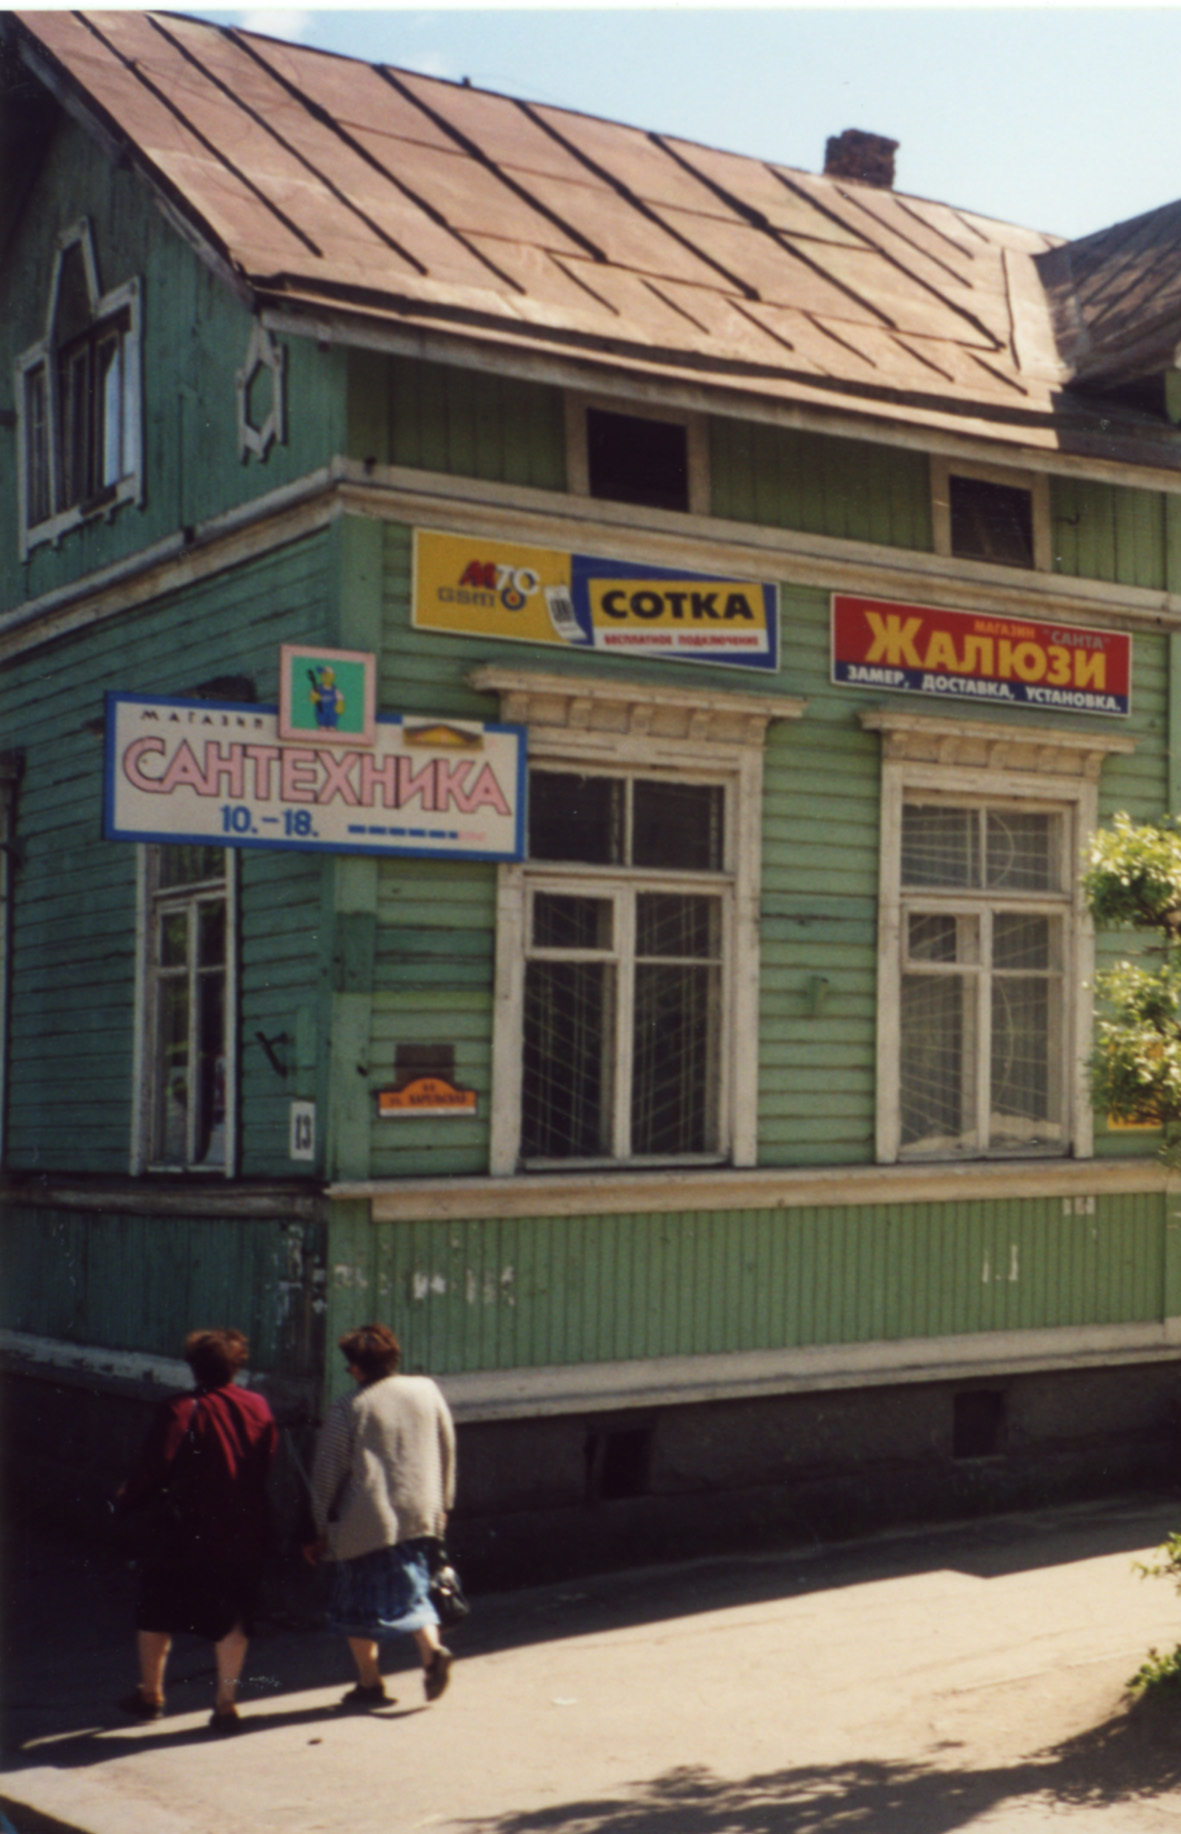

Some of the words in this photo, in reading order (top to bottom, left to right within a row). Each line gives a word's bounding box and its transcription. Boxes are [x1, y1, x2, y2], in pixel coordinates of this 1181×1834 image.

[600, 589, 755, 620] СОТКА
[604, 633, 673, 647] БЕСПЛАТНОЕ
[678, 634, 759, 648] ПОДКЛЮЧЕНИЕ
[974, 619, 1036, 639] МАГАЗИН
[864, 611, 1107, 690] ЖАЛЮЗИ
[847, 665, 910, 689] ЗАМЕР,
[921, 673, 1015, 701] ДОСТАВКА,
[1025, 687, 1121, 712] УСТАНОВКА.
[140, 709, 265, 731] МАГАЗИН
[122, 736, 511, 817] САНТЕХНИКА
